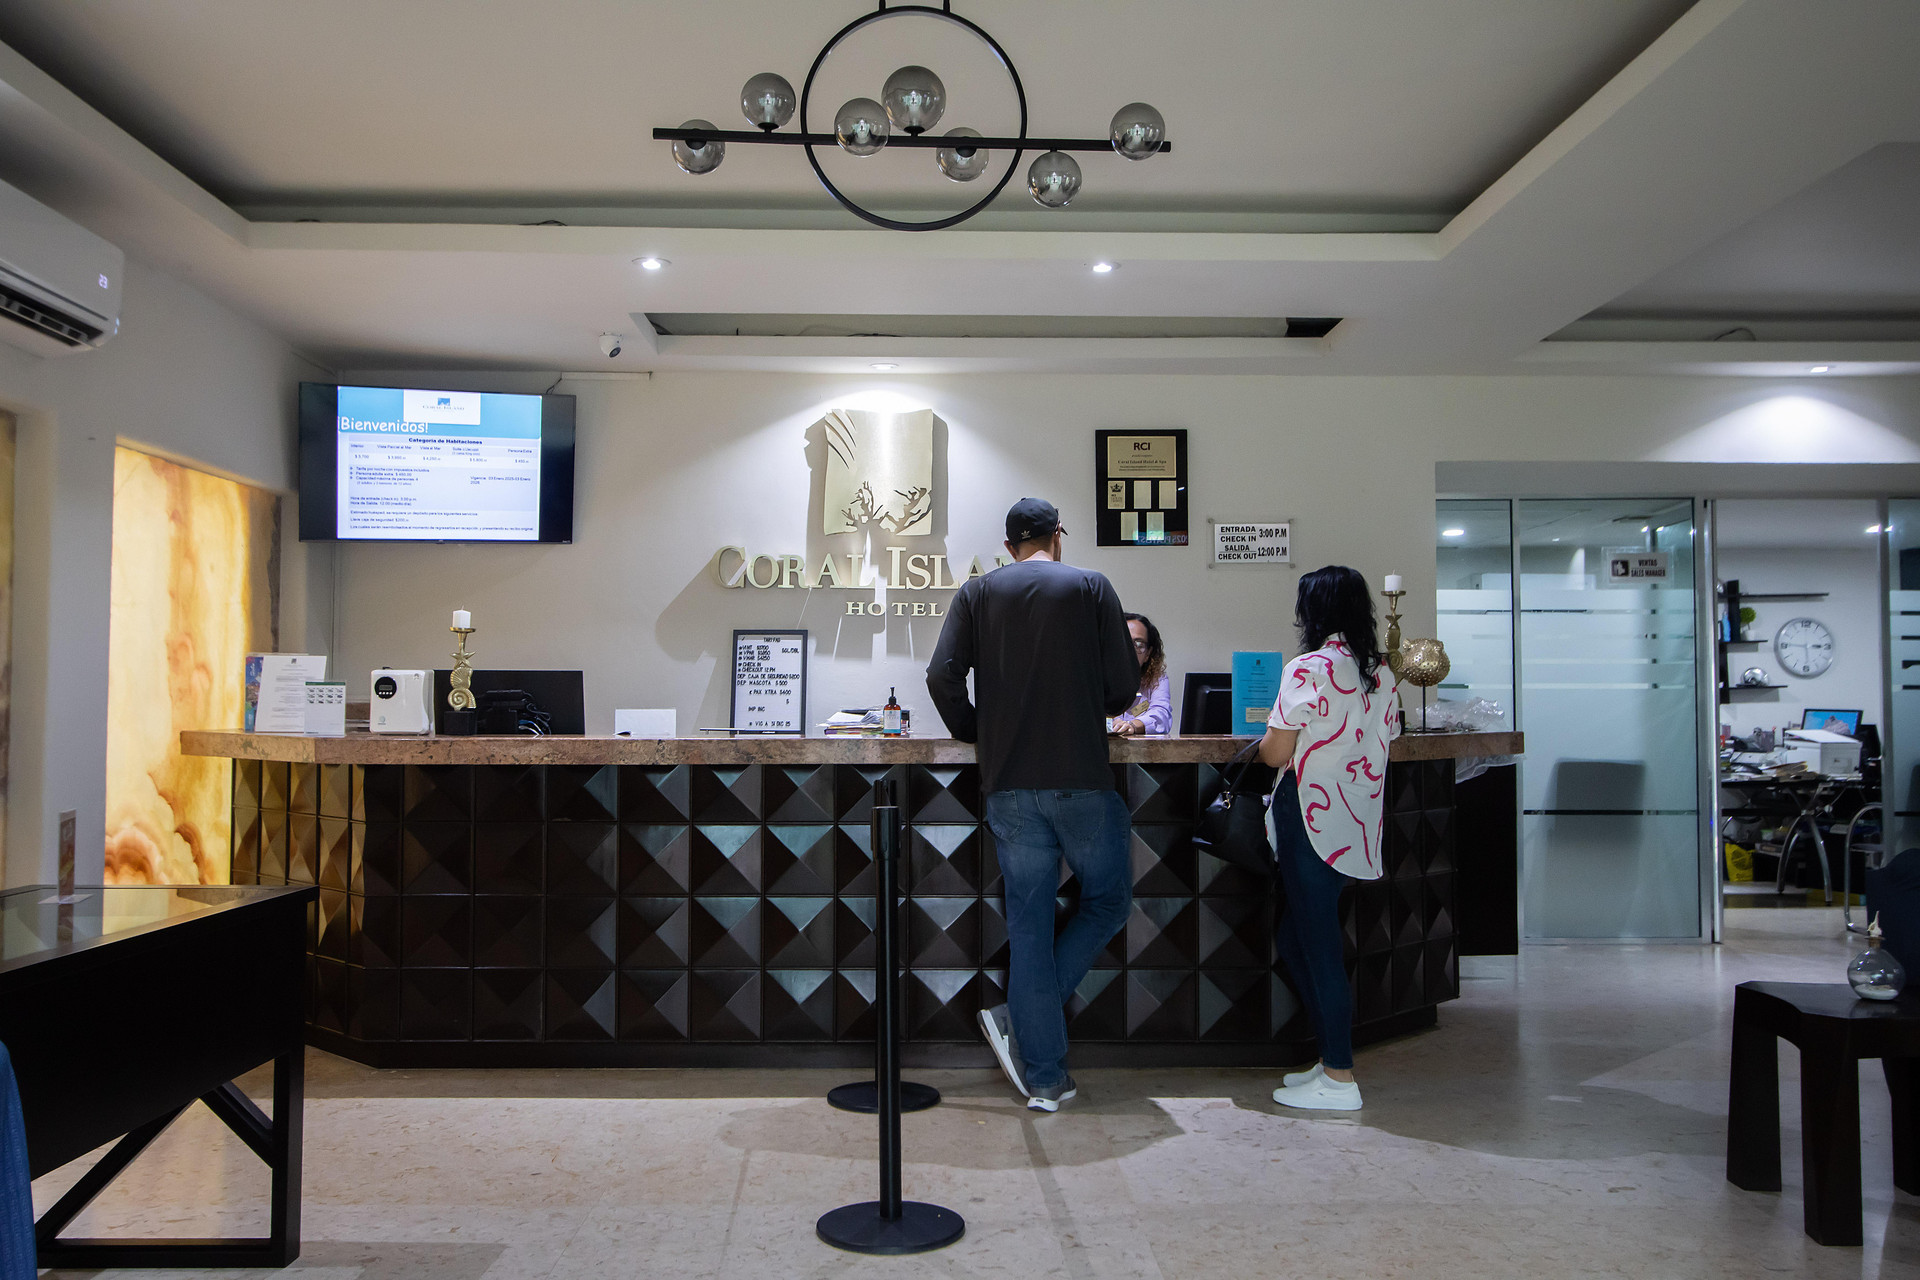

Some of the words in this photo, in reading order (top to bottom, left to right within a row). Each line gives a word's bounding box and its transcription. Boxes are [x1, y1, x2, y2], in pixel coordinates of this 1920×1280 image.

[1133, 442, 1151, 450] RCI
[1259, 528, 1274, 538] 3:00
[1275, 528, 1287, 538] P.M
[1224, 544, 1250, 552] SALIDA
[1257, 547, 1275, 557] 12:00
[1276, 547, 1287, 556] P.M
[1638, 559, 1658, 567] VENTAS
[711, 545, 876, 589] CORAL
[886, 546, 1014, 590] ISLA
[1631, 569, 1644, 577] SALES
[1645, 569, 1666, 577] MANAGER
[845, 601, 944, 617] HOTEL
[1801, 620, 1812, 628] 12
[1823, 643, 1832, 651] 3
[1803, 665, 1810, 673] 6
